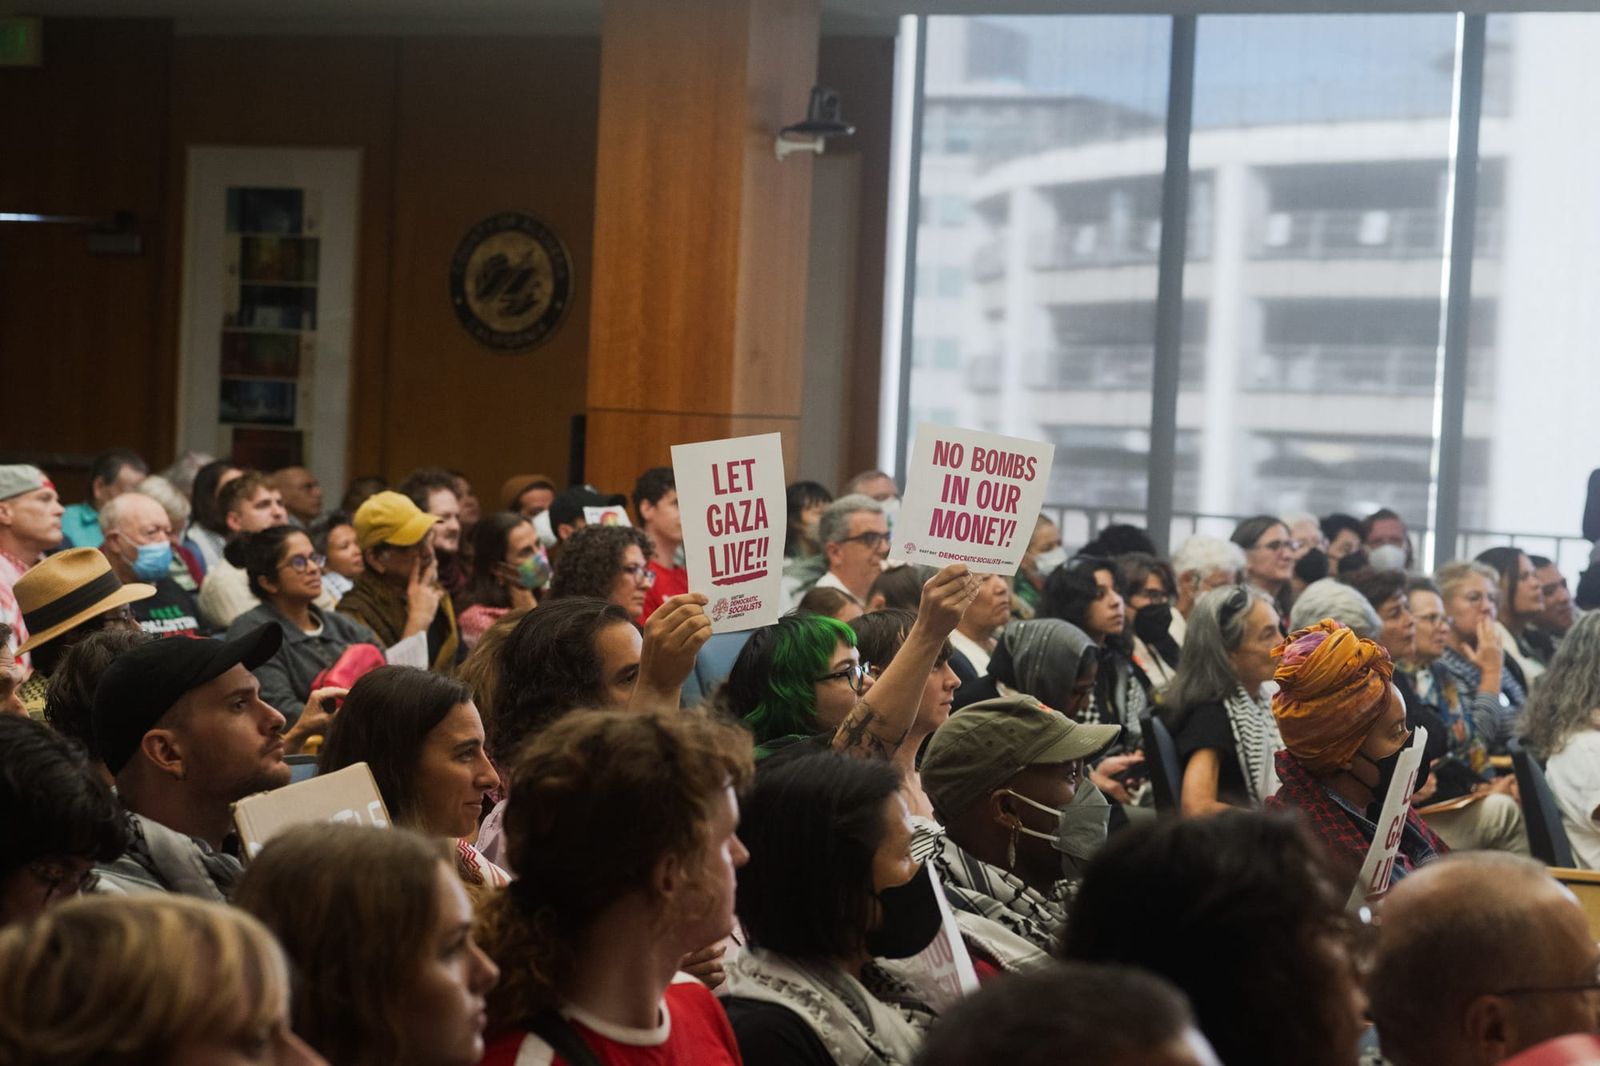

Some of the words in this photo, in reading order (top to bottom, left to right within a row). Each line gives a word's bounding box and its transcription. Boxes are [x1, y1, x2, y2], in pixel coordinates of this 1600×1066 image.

[712, 459, 755, 495] LET
[932, 440, 964, 469] NO
[970, 446, 1037, 481] BOMBS
[941, 474, 970, 506] IN
[976, 480, 1021, 514] OUR
[707, 498, 768, 537] GAZA
[929, 508, 1017, 547] MONEY!
[709, 537, 769, 577] LIVE!!
[938, 551, 977, 563] DEMOCRATIC
[976, 556, 1002, 565] SOCIALISTS
[729, 601, 762, 614] SOCIALISTS
[730, 595, 759, 606] DEMOCRATIC
